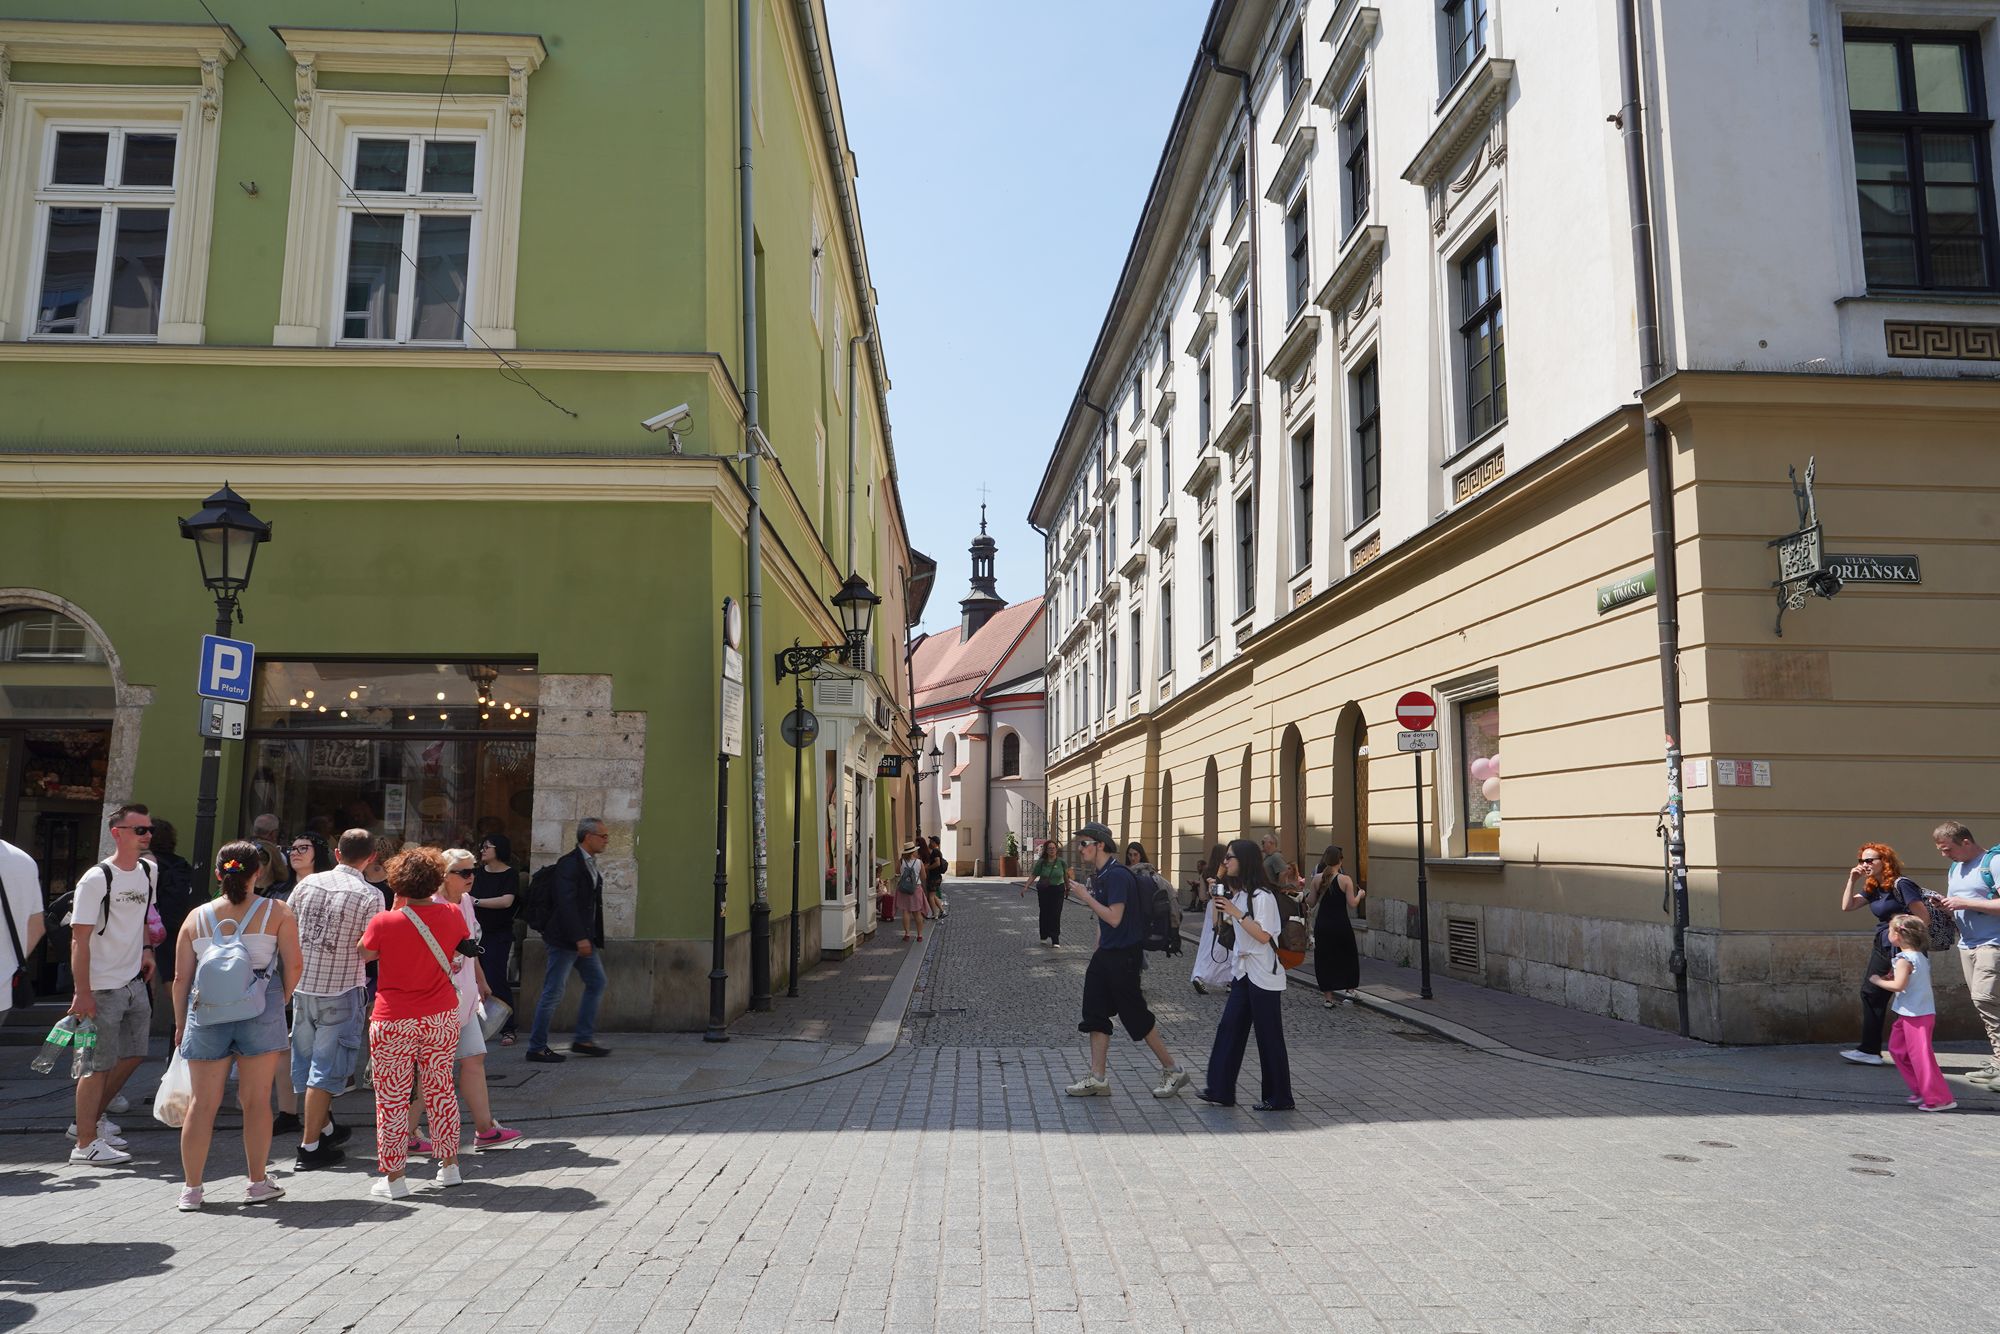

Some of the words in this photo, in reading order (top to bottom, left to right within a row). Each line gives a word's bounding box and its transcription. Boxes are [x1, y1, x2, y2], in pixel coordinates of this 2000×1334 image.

[1788, 547, 1810, 564] POD
[1845, 557, 1876, 565] ULICA
[1829, 563, 1917, 580] ORIAŃSKA
[1613, 581, 1647, 603] TOMASZA
[210, 643, 243, 691] P
[221, 683, 245, 696] Płatny
